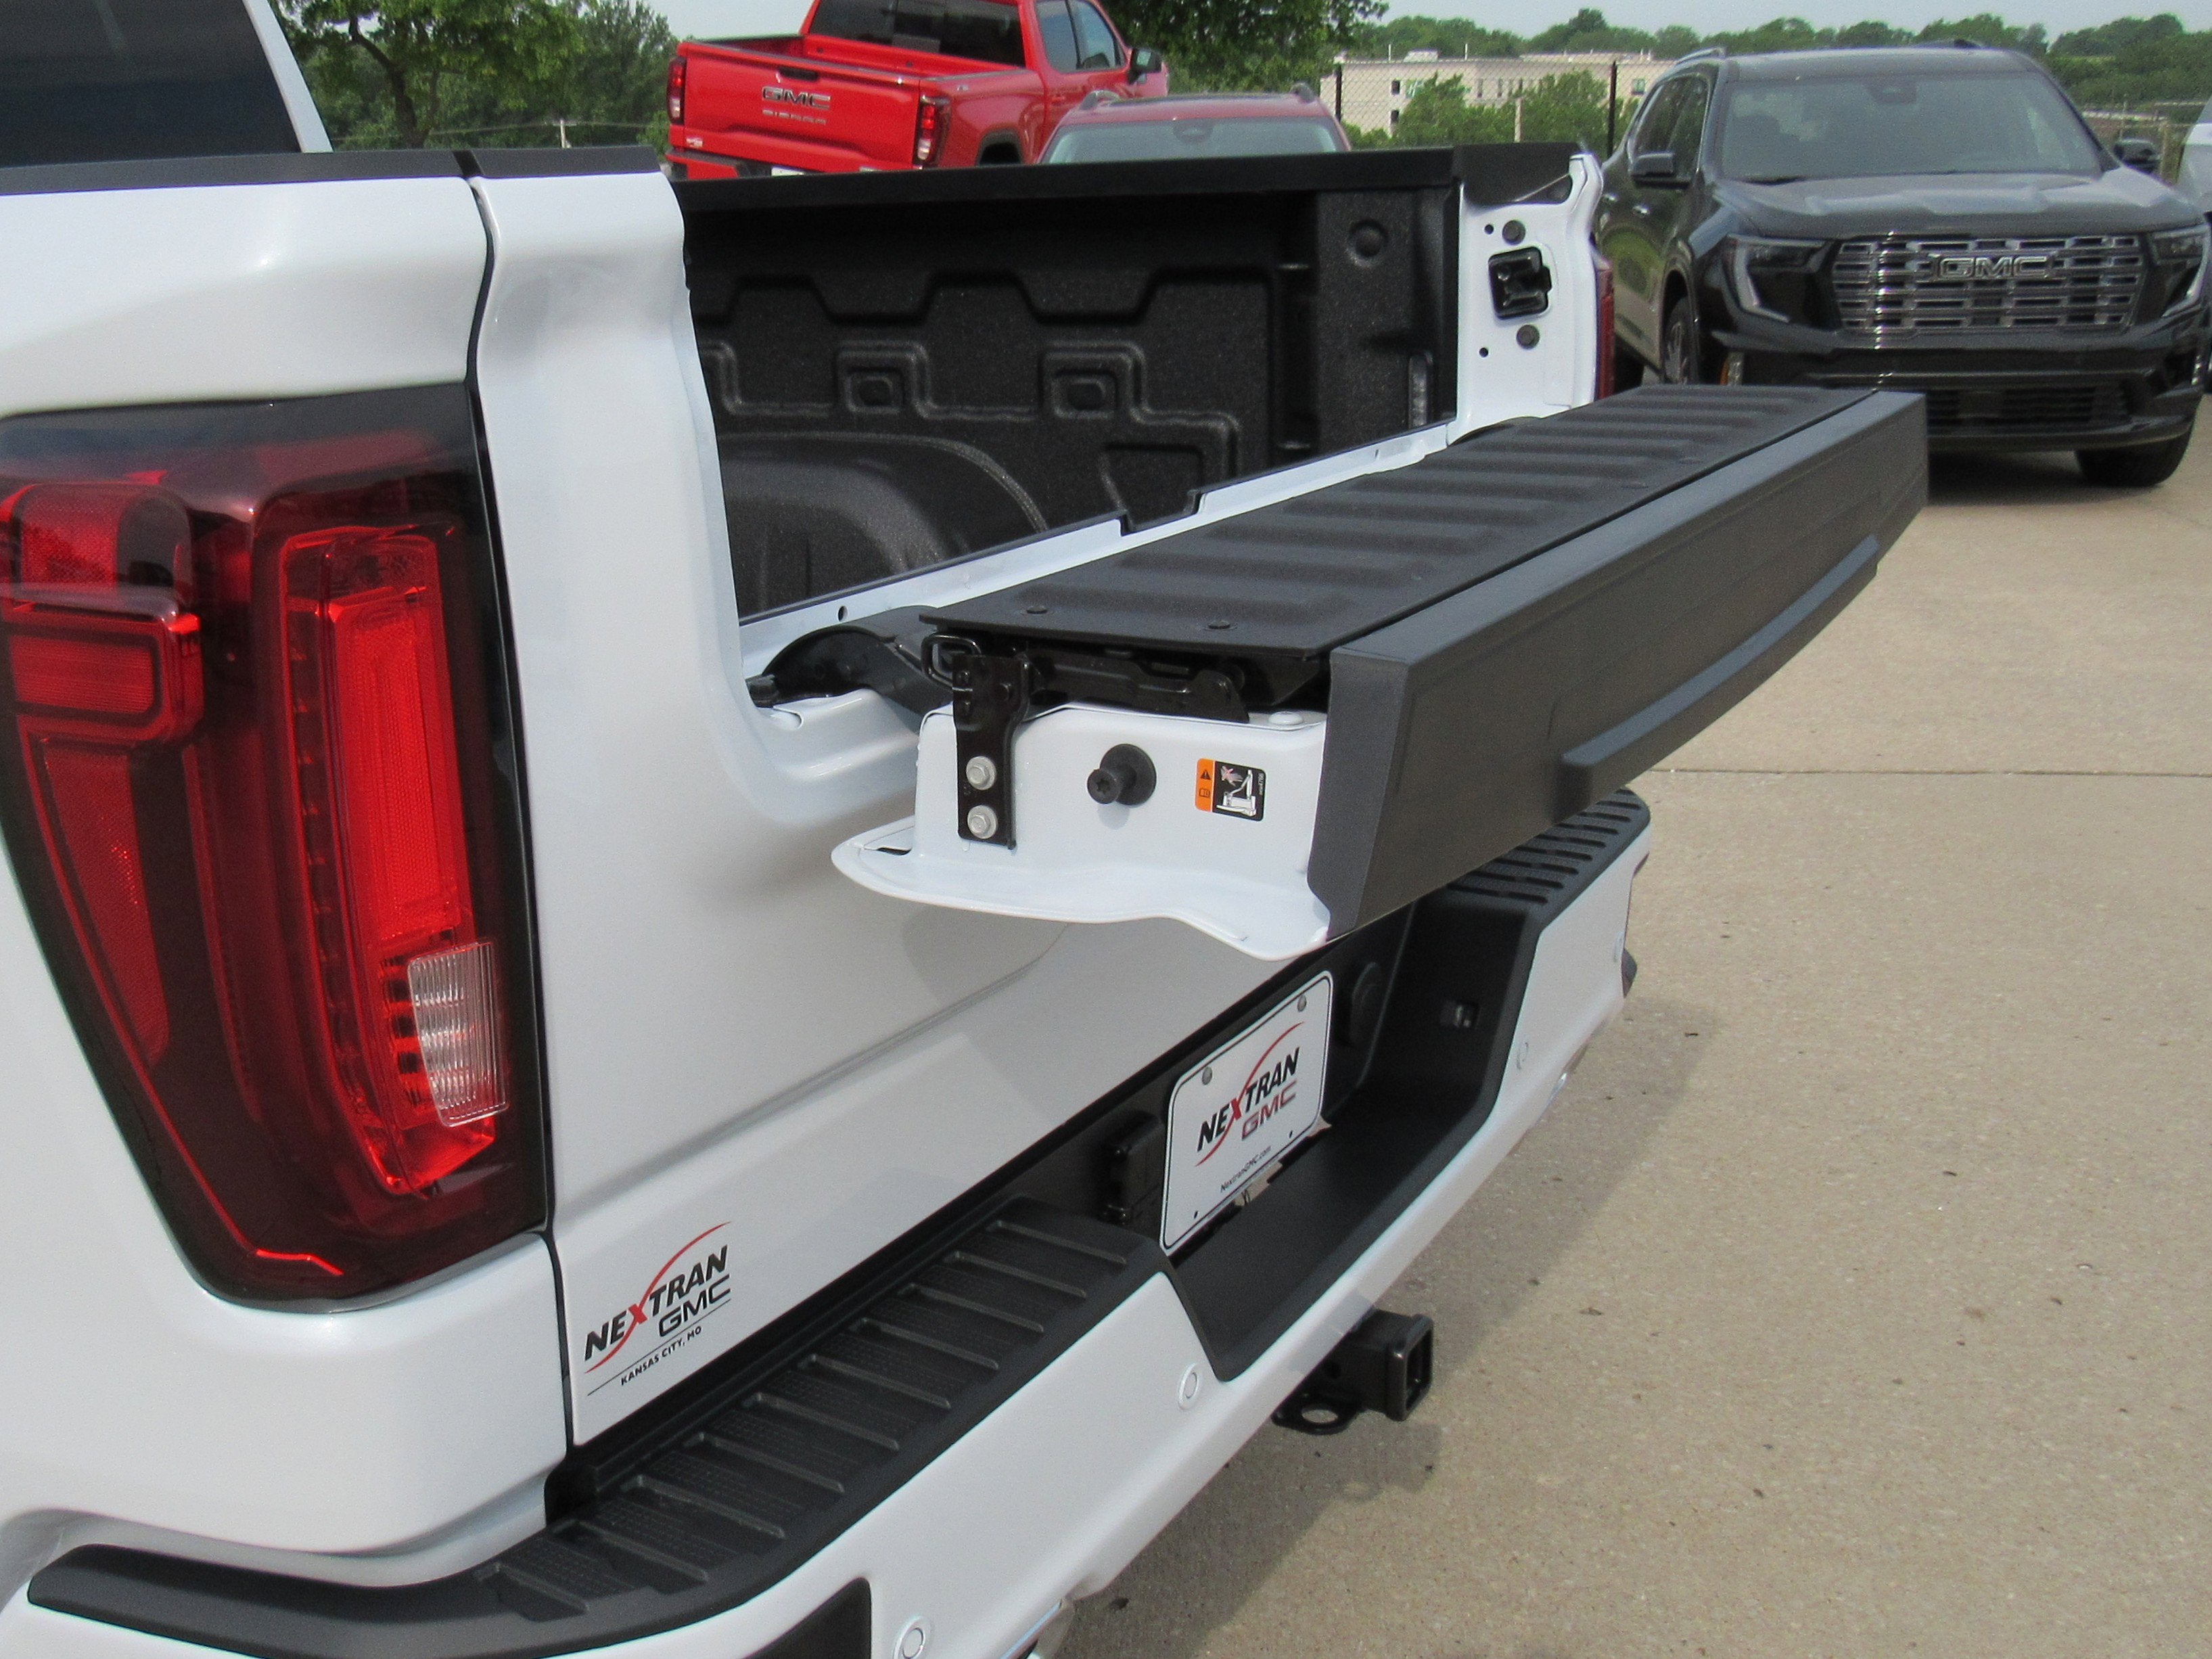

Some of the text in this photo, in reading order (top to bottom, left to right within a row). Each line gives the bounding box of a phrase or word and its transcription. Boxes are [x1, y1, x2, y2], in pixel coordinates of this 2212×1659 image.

[762, 86, 831, 110] GMC
[1939, 255, 2048, 279] GMC
[1197, 1047, 1299, 1152] NEXTRAN
[1241, 1081, 1297, 1141] GMC
[584, 1244, 728, 1361] NEXTRAN
[658, 1273, 731, 1338] GMC
[620, 1325, 702, 1386] KANSAS CITY, MO
